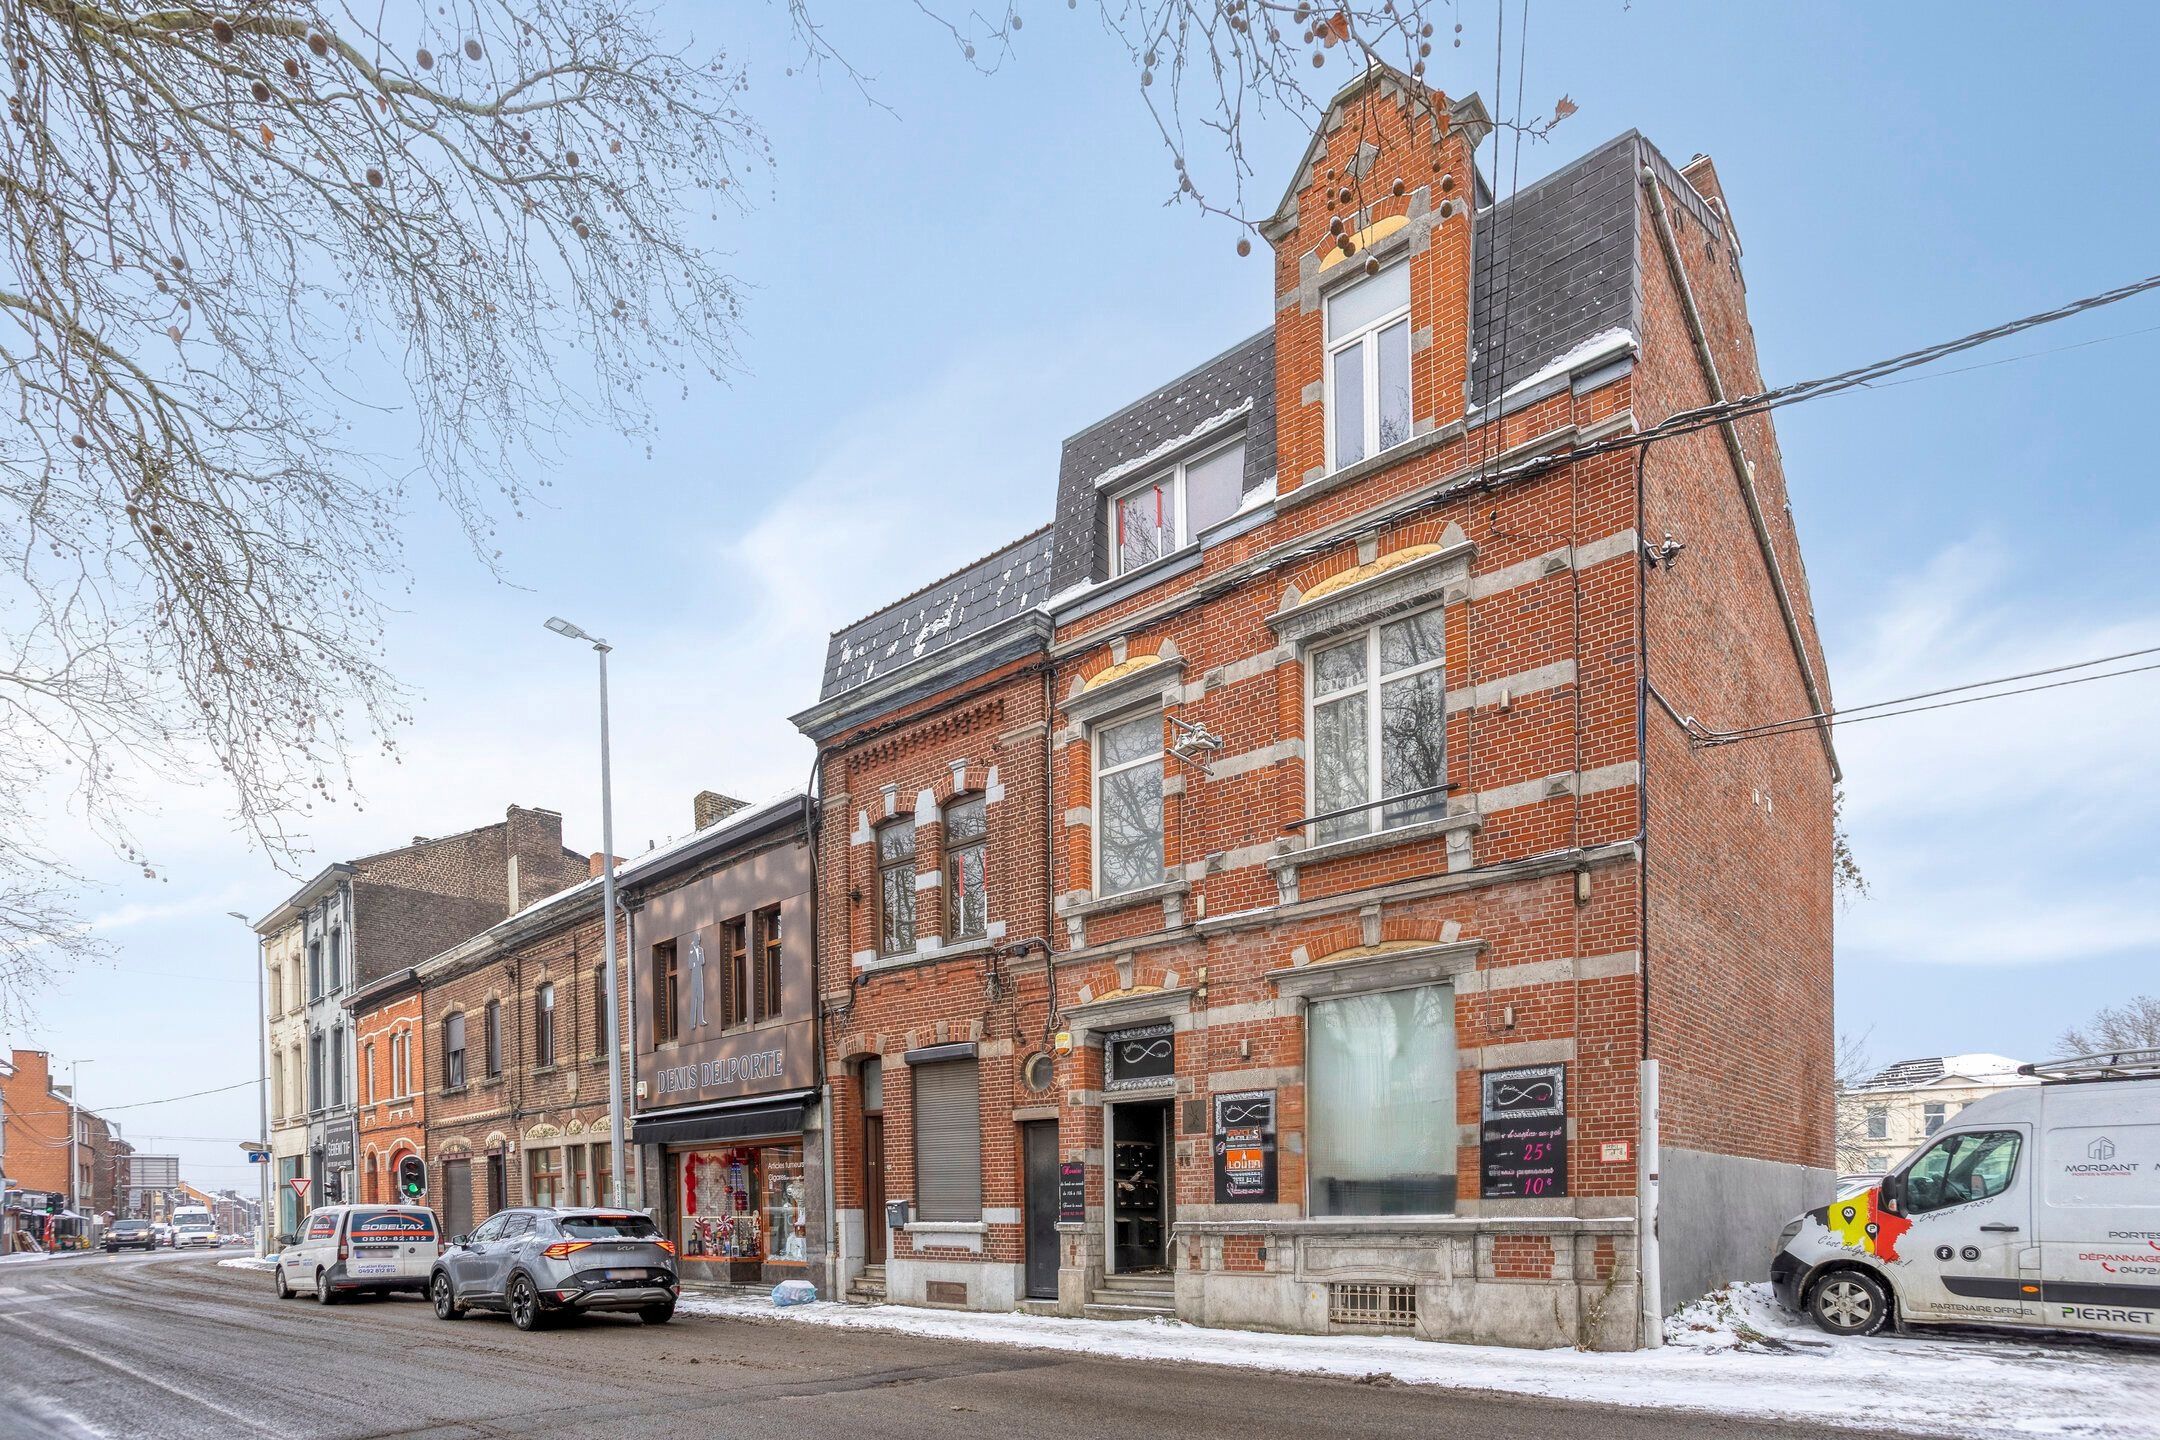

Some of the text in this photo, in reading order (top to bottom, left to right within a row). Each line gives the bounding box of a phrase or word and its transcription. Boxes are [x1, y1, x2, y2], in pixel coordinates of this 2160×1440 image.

[657, 1049, 783, 1094] DENIS DELPORTE
[2065, 1163, 2139, 1172] MORDANT
[1919, 1208, 1957, 1222] Depuis
[361, 1223, 425, 1231] SOBELTAX
[1930, 1302, 1992, 1313] PARTENAIRE
[2061, 1306, 2154, 1324] PIERRET
